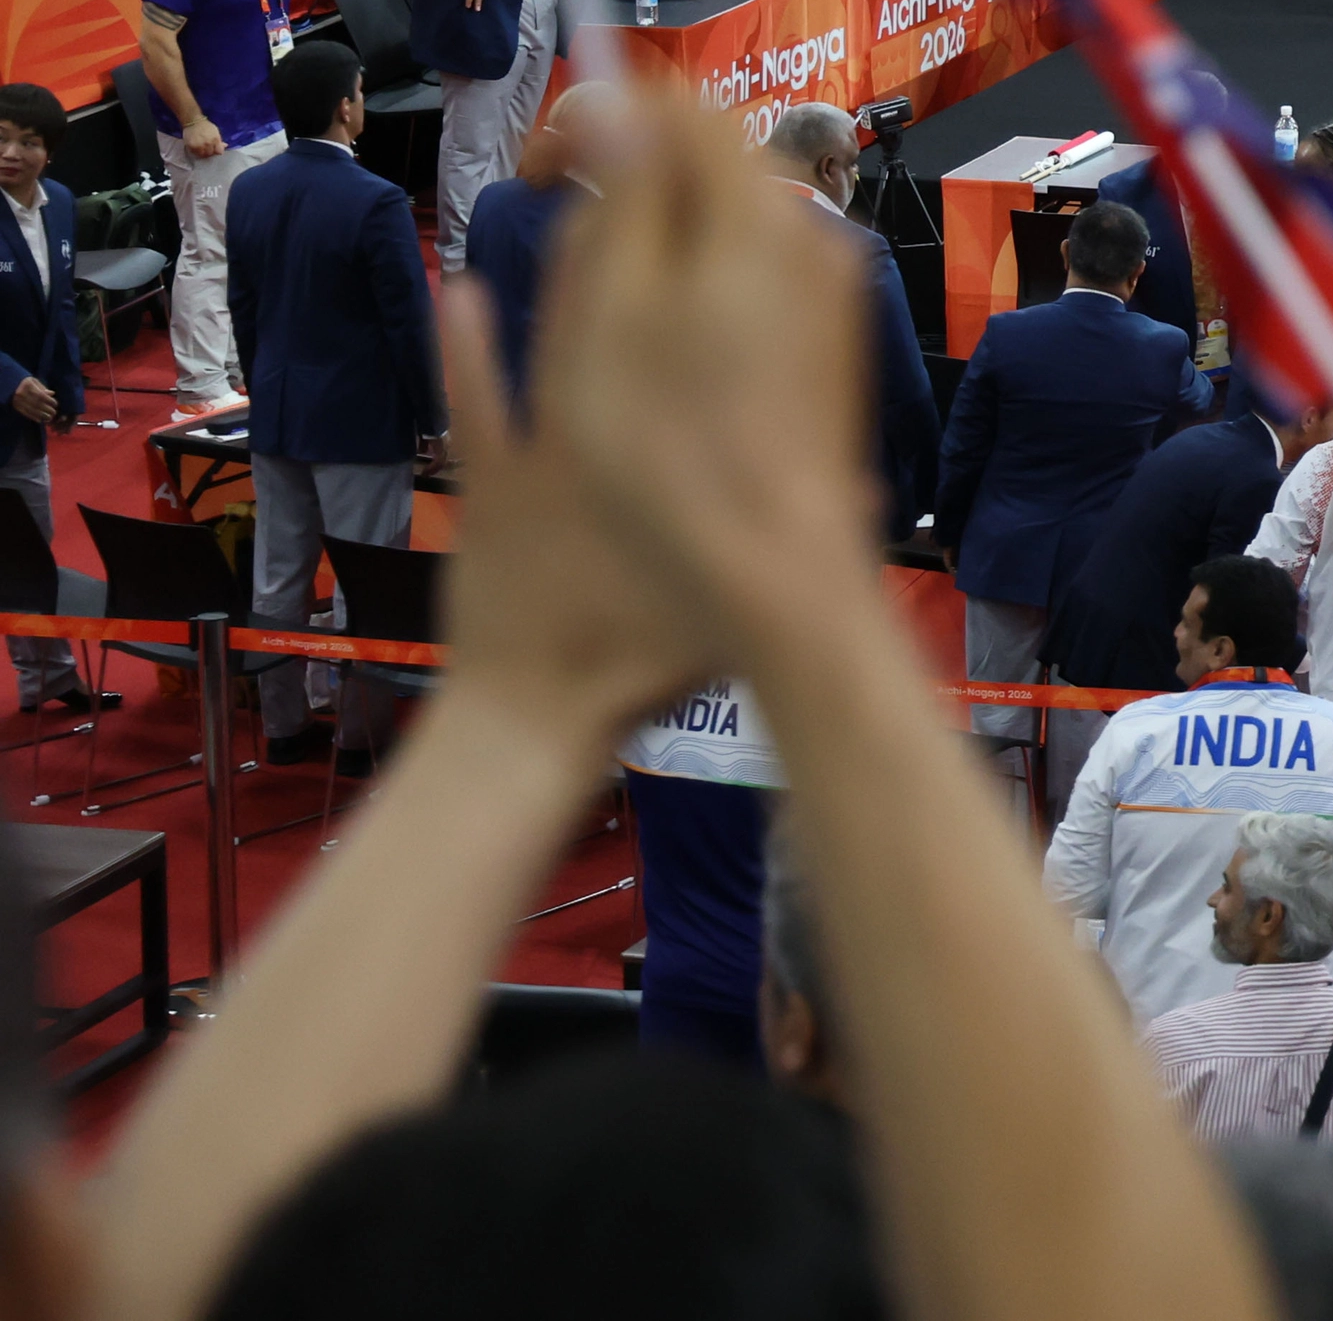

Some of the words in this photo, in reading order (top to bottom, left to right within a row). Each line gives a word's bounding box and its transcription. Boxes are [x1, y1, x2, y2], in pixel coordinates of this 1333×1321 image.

[919, 14, 966, 73] 2026
[1008, 689, 1033, 700] 2026
[1173, 714, 1316, 772] INDIA
